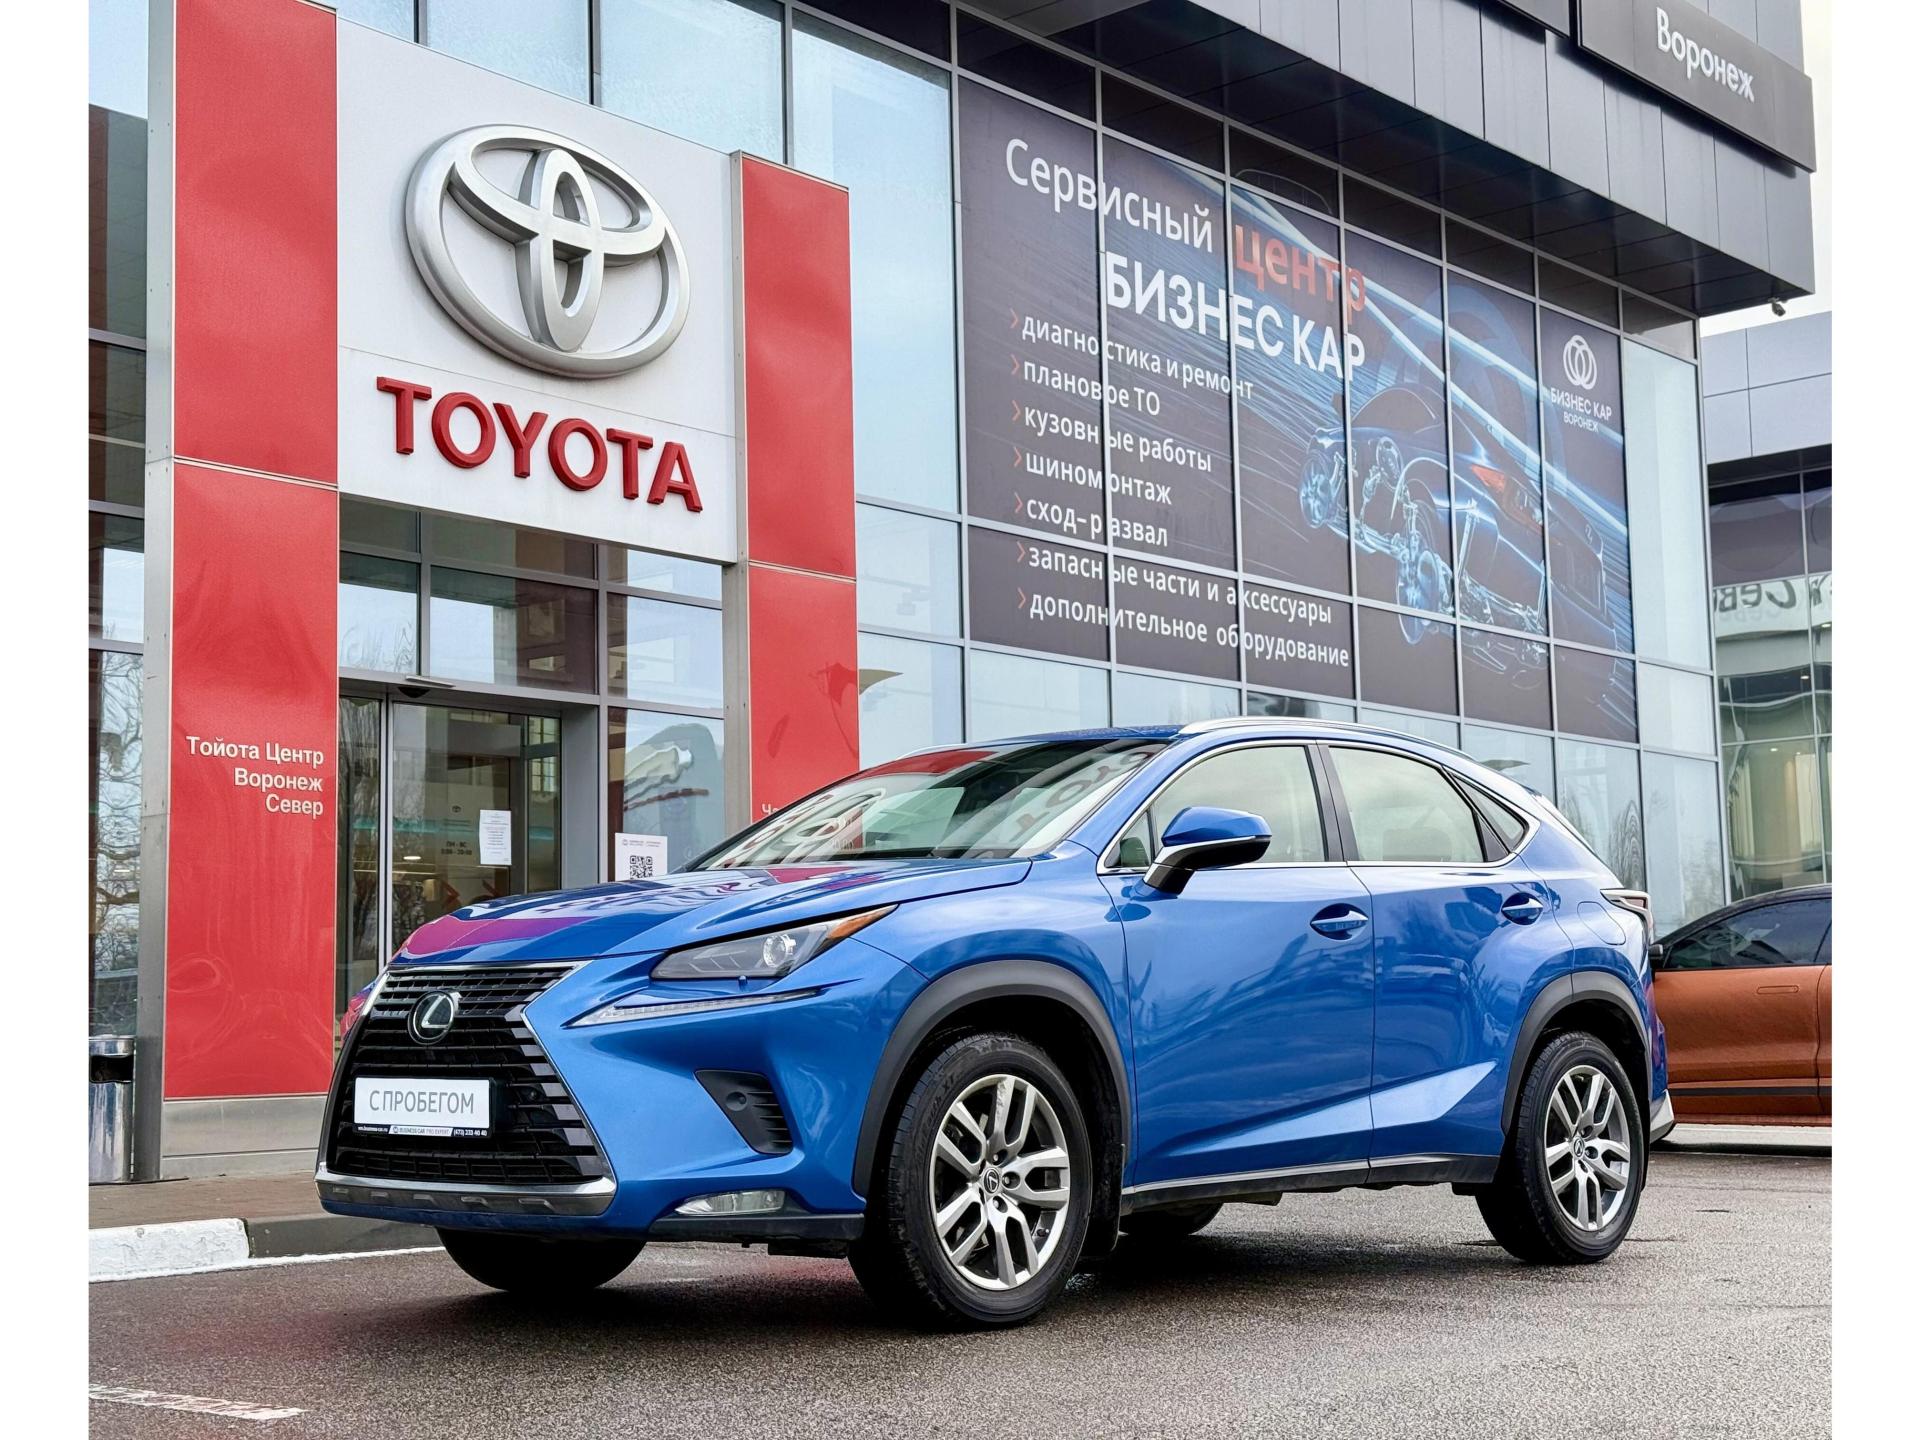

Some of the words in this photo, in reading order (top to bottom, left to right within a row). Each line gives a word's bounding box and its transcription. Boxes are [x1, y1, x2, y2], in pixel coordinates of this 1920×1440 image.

[1656, 7, 1755, 102] Воронеж
[1005, 137, 1213, 253] Сервисный
[1235, 224, 1366, 325] центр
[1105, 252, 1284, 358] БИЗНЕС
[1293, 318, 1366, 382] КАР
[1022, 314, 1162, 374] диагностика
[1166, 359, 1179, 379] и
[1183, 364, 1254, 400] ремонт
[1023, 360, 1130, 409] плановое
[1135, 387, 1161, 416] ТО
[1550, 387, 1592, 415] БИЗНЕС
[1593, 402, 1612, 421] КАР
[1563, 411, 1599, 433] ВОРОНЕЖ
[376, 376, 704, 513] TOYOTA
[1024, 405, 1134, 453] кузовные
[1139, 436, 1212, 473] работы
[1026, 452, 1172, 506] шиномонтаж
[1028, 546, 1138, 587] запасные
[1143, 568, 1200, 599] части
[1207, 583, 1219, 602] и
[1226, 587, 1332, 625] аксессуары
[1030, 594, 1208, 643] дополнительное
[1216, 624, 1350, 667] оборудование
[186, 735, 260, 760] Тойота
[266, 742, 324, 769] Центр
[234, 768, 323, 793] Воронеж
[266, 793, 324, 819] Север
[369, 1090, 380, 1111] С
[382, 1090, 475, 1114] ПРОБЕГОМ
